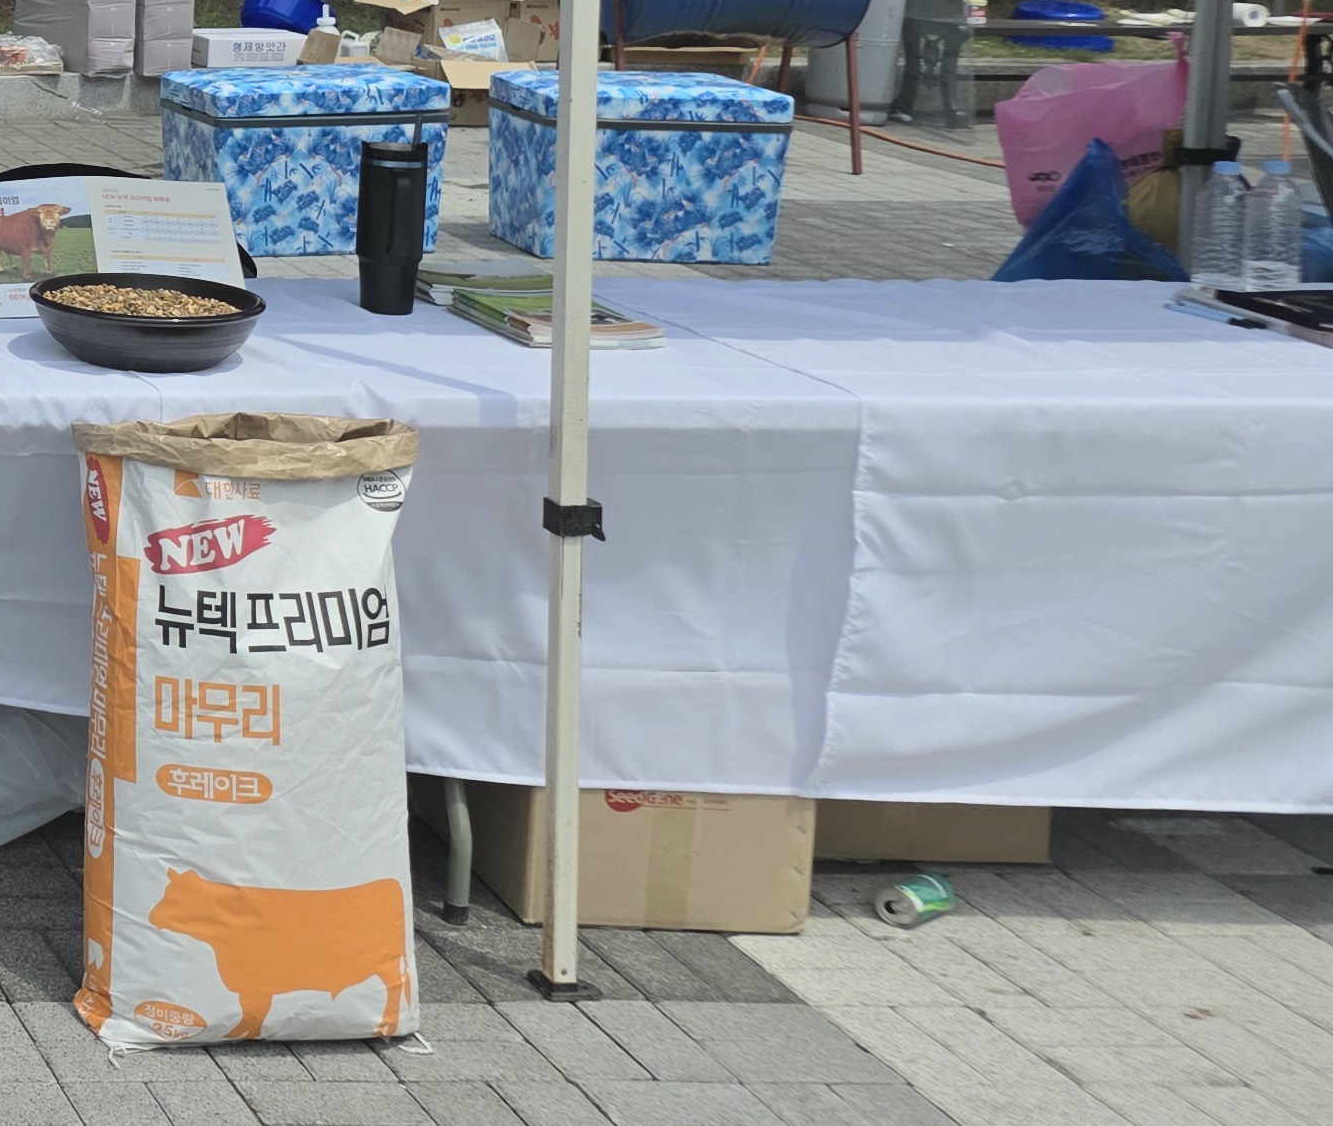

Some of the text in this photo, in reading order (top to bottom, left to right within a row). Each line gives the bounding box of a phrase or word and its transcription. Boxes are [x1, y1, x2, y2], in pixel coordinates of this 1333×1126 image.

[233, 42, 286, 52] 형제방앗간
[88, 469, 108, 524] NEW
[205, 475, 262, 501] 대한사료
[364, 483, 399, 493] HACCP
[157, 516, 246, 570] NEW
[154, 585, 391, 654] 뉴텍 프리미엄
[155, 676, 282, 746] 마무리
[168, 768, 262, 802] 후레이크
[144, 1003, 196, 1026] 정미중량
